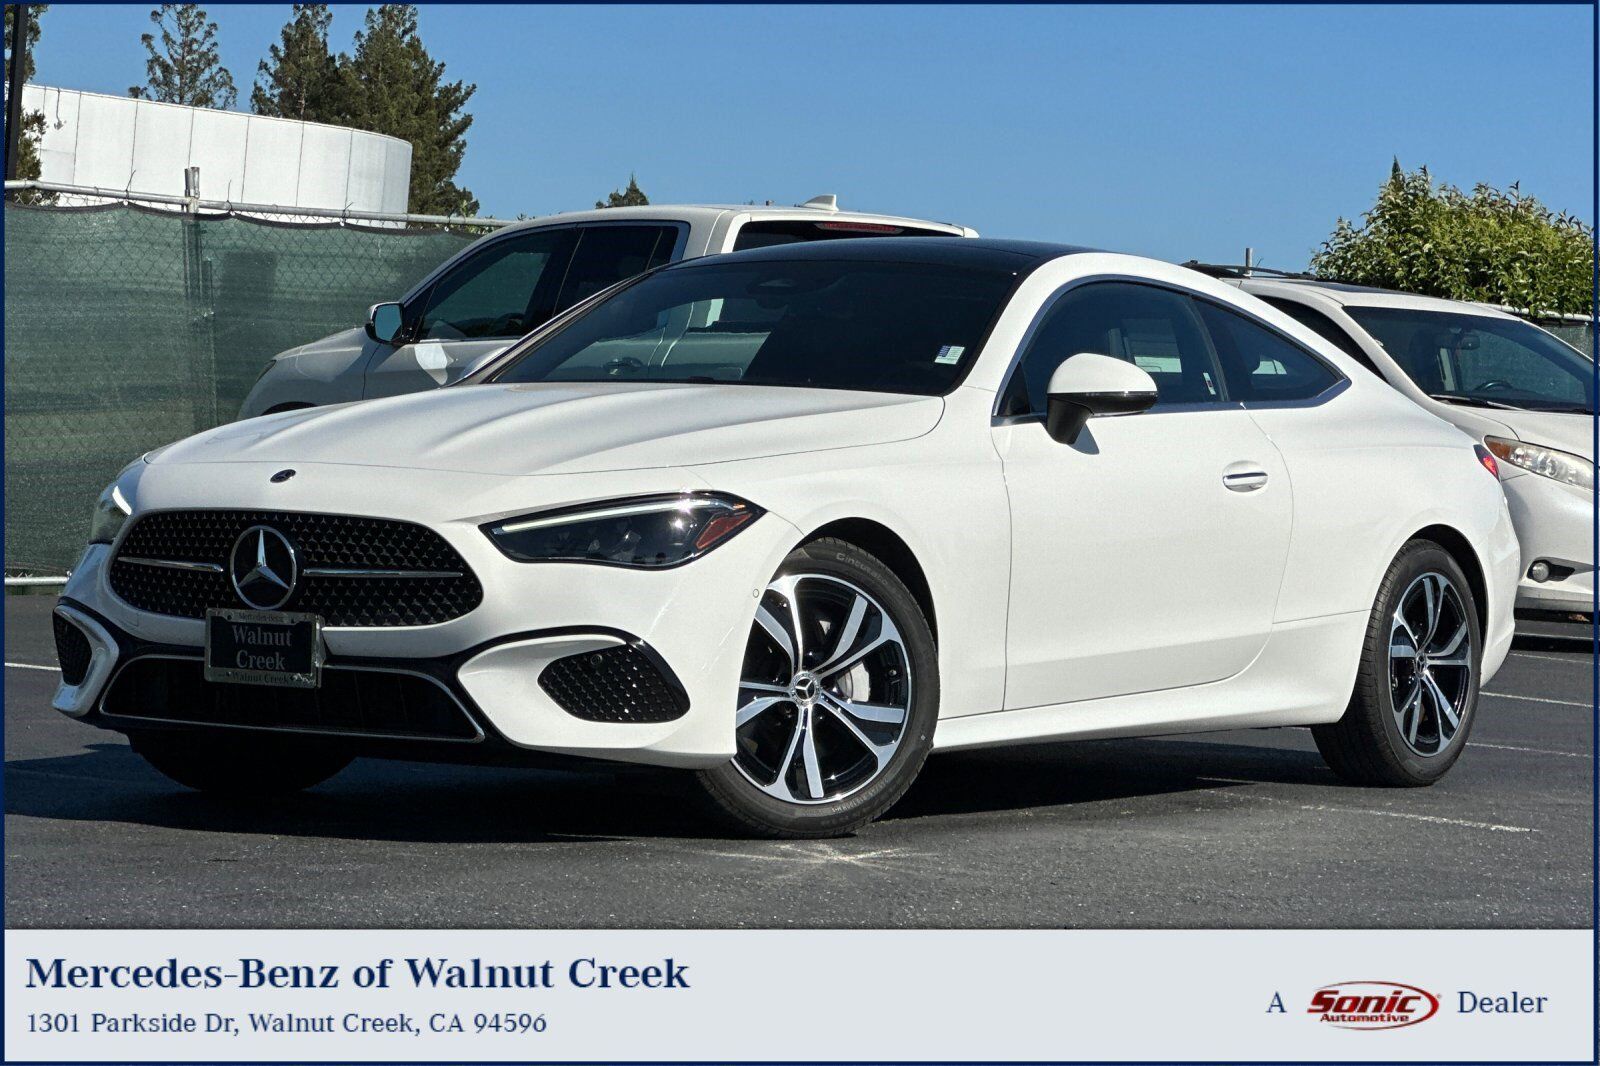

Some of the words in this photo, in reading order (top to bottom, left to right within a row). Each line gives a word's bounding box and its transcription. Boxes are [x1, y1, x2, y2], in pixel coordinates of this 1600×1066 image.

[232, 624, 293, 647] Walnut
[236, 649, 286, 671] Creek
[231, 671, 263, 682] Walnut
[264, 674, 289, 684] Creek
